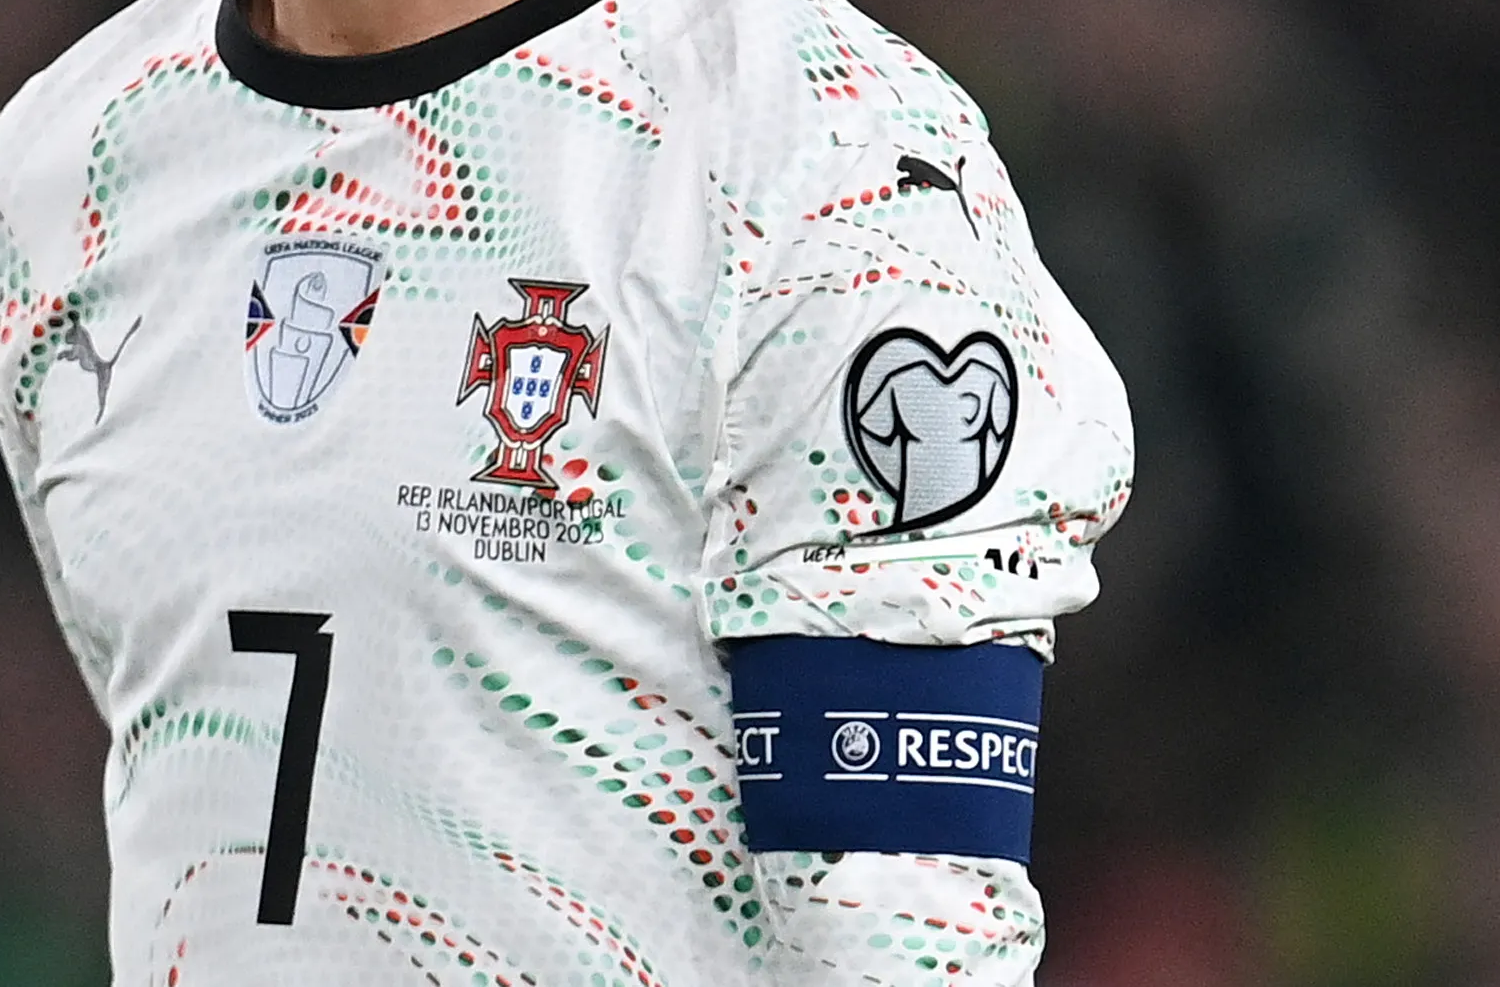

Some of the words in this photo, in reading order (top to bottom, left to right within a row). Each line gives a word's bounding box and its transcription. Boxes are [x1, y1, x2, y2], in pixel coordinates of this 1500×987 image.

[397, 483, 432, 509] REP.
[437, 487, 627, 522] IRLANDA/PORTUGAL
[415, 509, 431, 532] 13
[438, 511, 551, 540] NOVEMBRO
[555, 521, 605, 546] 2025
[474, 538, 547, 563] DUBLIN
[802, 545, 847, 563] UEFA
[226, 609, 335, 926] 7
[897, 727, 1040, 779] RESPECT
